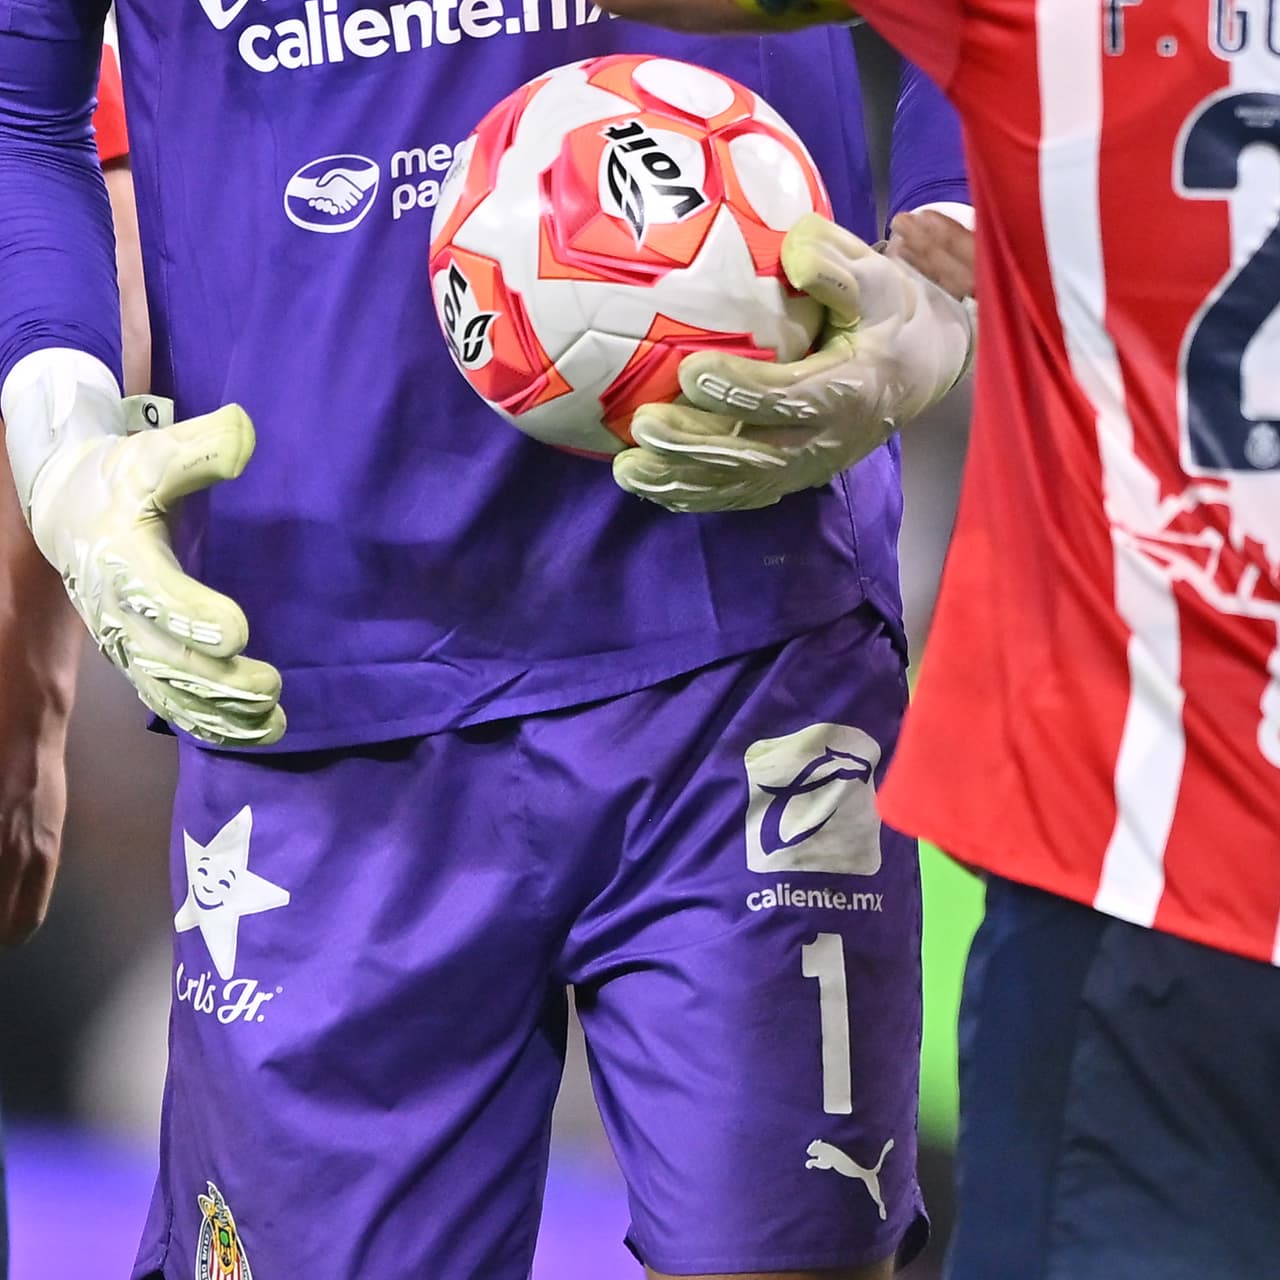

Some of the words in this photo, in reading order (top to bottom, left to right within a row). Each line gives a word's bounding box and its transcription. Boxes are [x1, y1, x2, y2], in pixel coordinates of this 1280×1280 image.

[746, 883, 884, 912] caliente.mx
[217, 978, 274, 1024] Jr.
[802, 933, 853, 1114] 1
